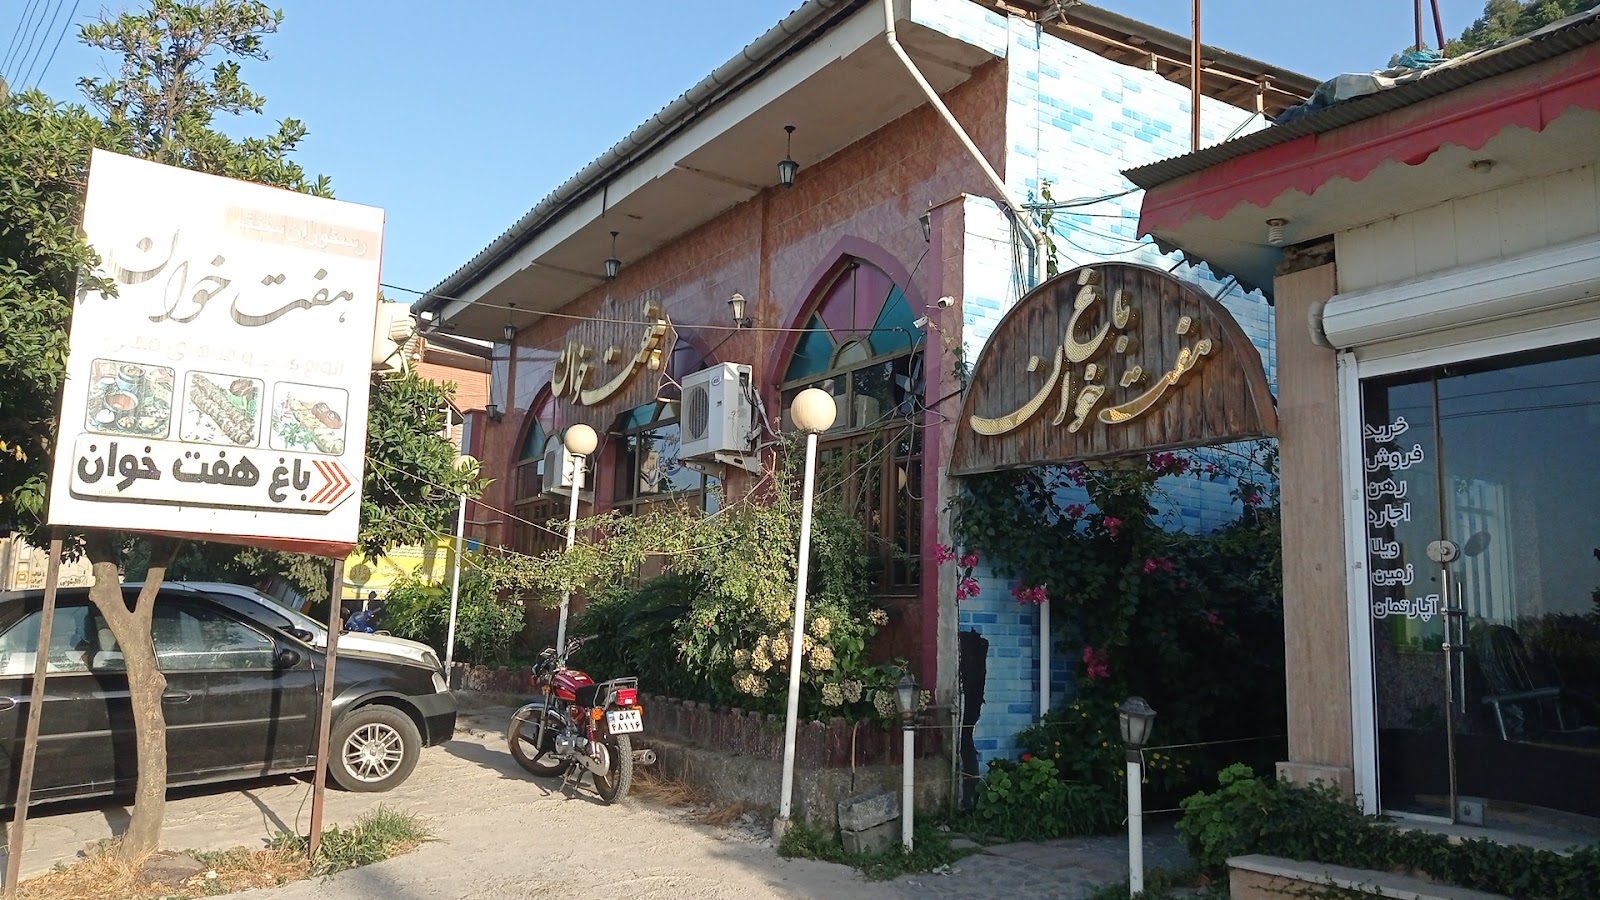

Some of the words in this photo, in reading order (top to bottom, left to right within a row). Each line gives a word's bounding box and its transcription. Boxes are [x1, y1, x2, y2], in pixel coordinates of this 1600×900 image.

[107, 228, 232, 323] خوان
[230, 268, 354, 327] هفت
[1064, 268, 1131, 363] باغ
[1099, 316, 1213, 424] هفت
[970, 345, 1105, 433] خوان
[1364, 416, 1409, 442] خرید
[77, 441, 162, 492] خوان
[172, 451, 260, 487] هفت
[1366, 444, 1424, 472] فروش
[267, 457, 311, 502] باغ
[1367, 478, 1407, 499] رهن
[1369, 503, 1411, 527] اجاره
[1370, 538, 1400, 559] ویلا
[1372, 564, 1414, 585] زمین
[1373, 594, 1440, 621] آپارتمان
